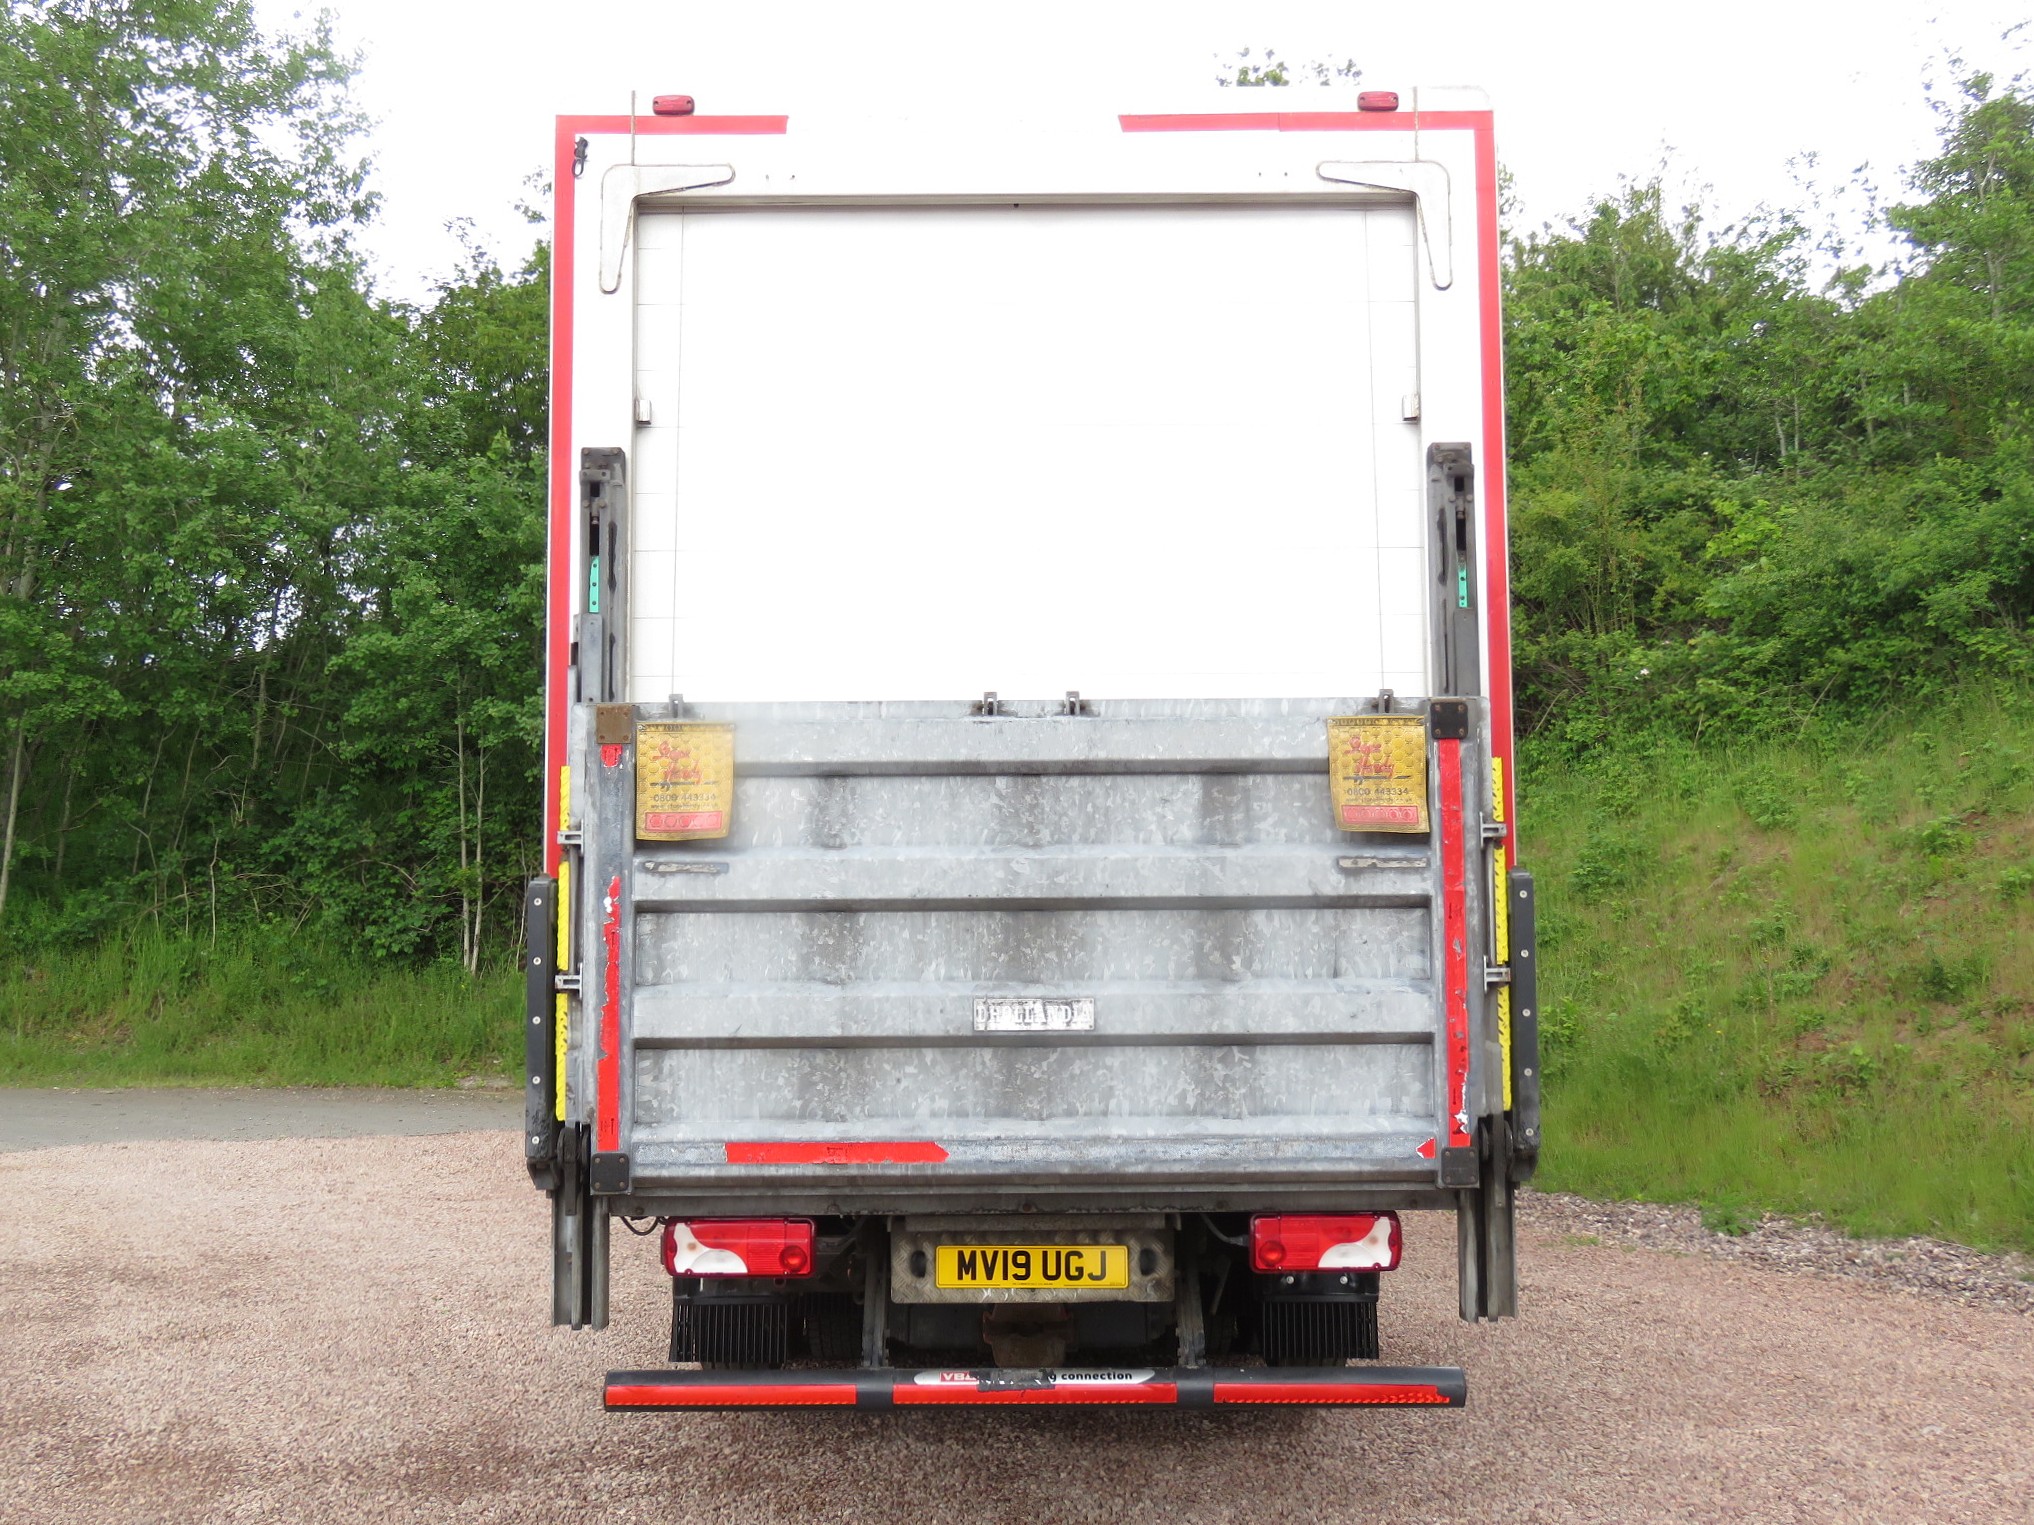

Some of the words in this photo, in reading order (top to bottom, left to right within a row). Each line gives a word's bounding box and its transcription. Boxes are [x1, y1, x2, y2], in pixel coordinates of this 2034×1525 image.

[1346, 787, 1371, 796] 0800
[1374, 786, 1410, 796] 443334
[653, 793, 678, 802] 0800
[976, 1000, 1092, 1023] DHOLLANDIA
[957, 1250, 1031, 1281] MV19
[1042, 1250, 1107, 1281] UGJ
[1061, 1371, 1133, 1381] connection
